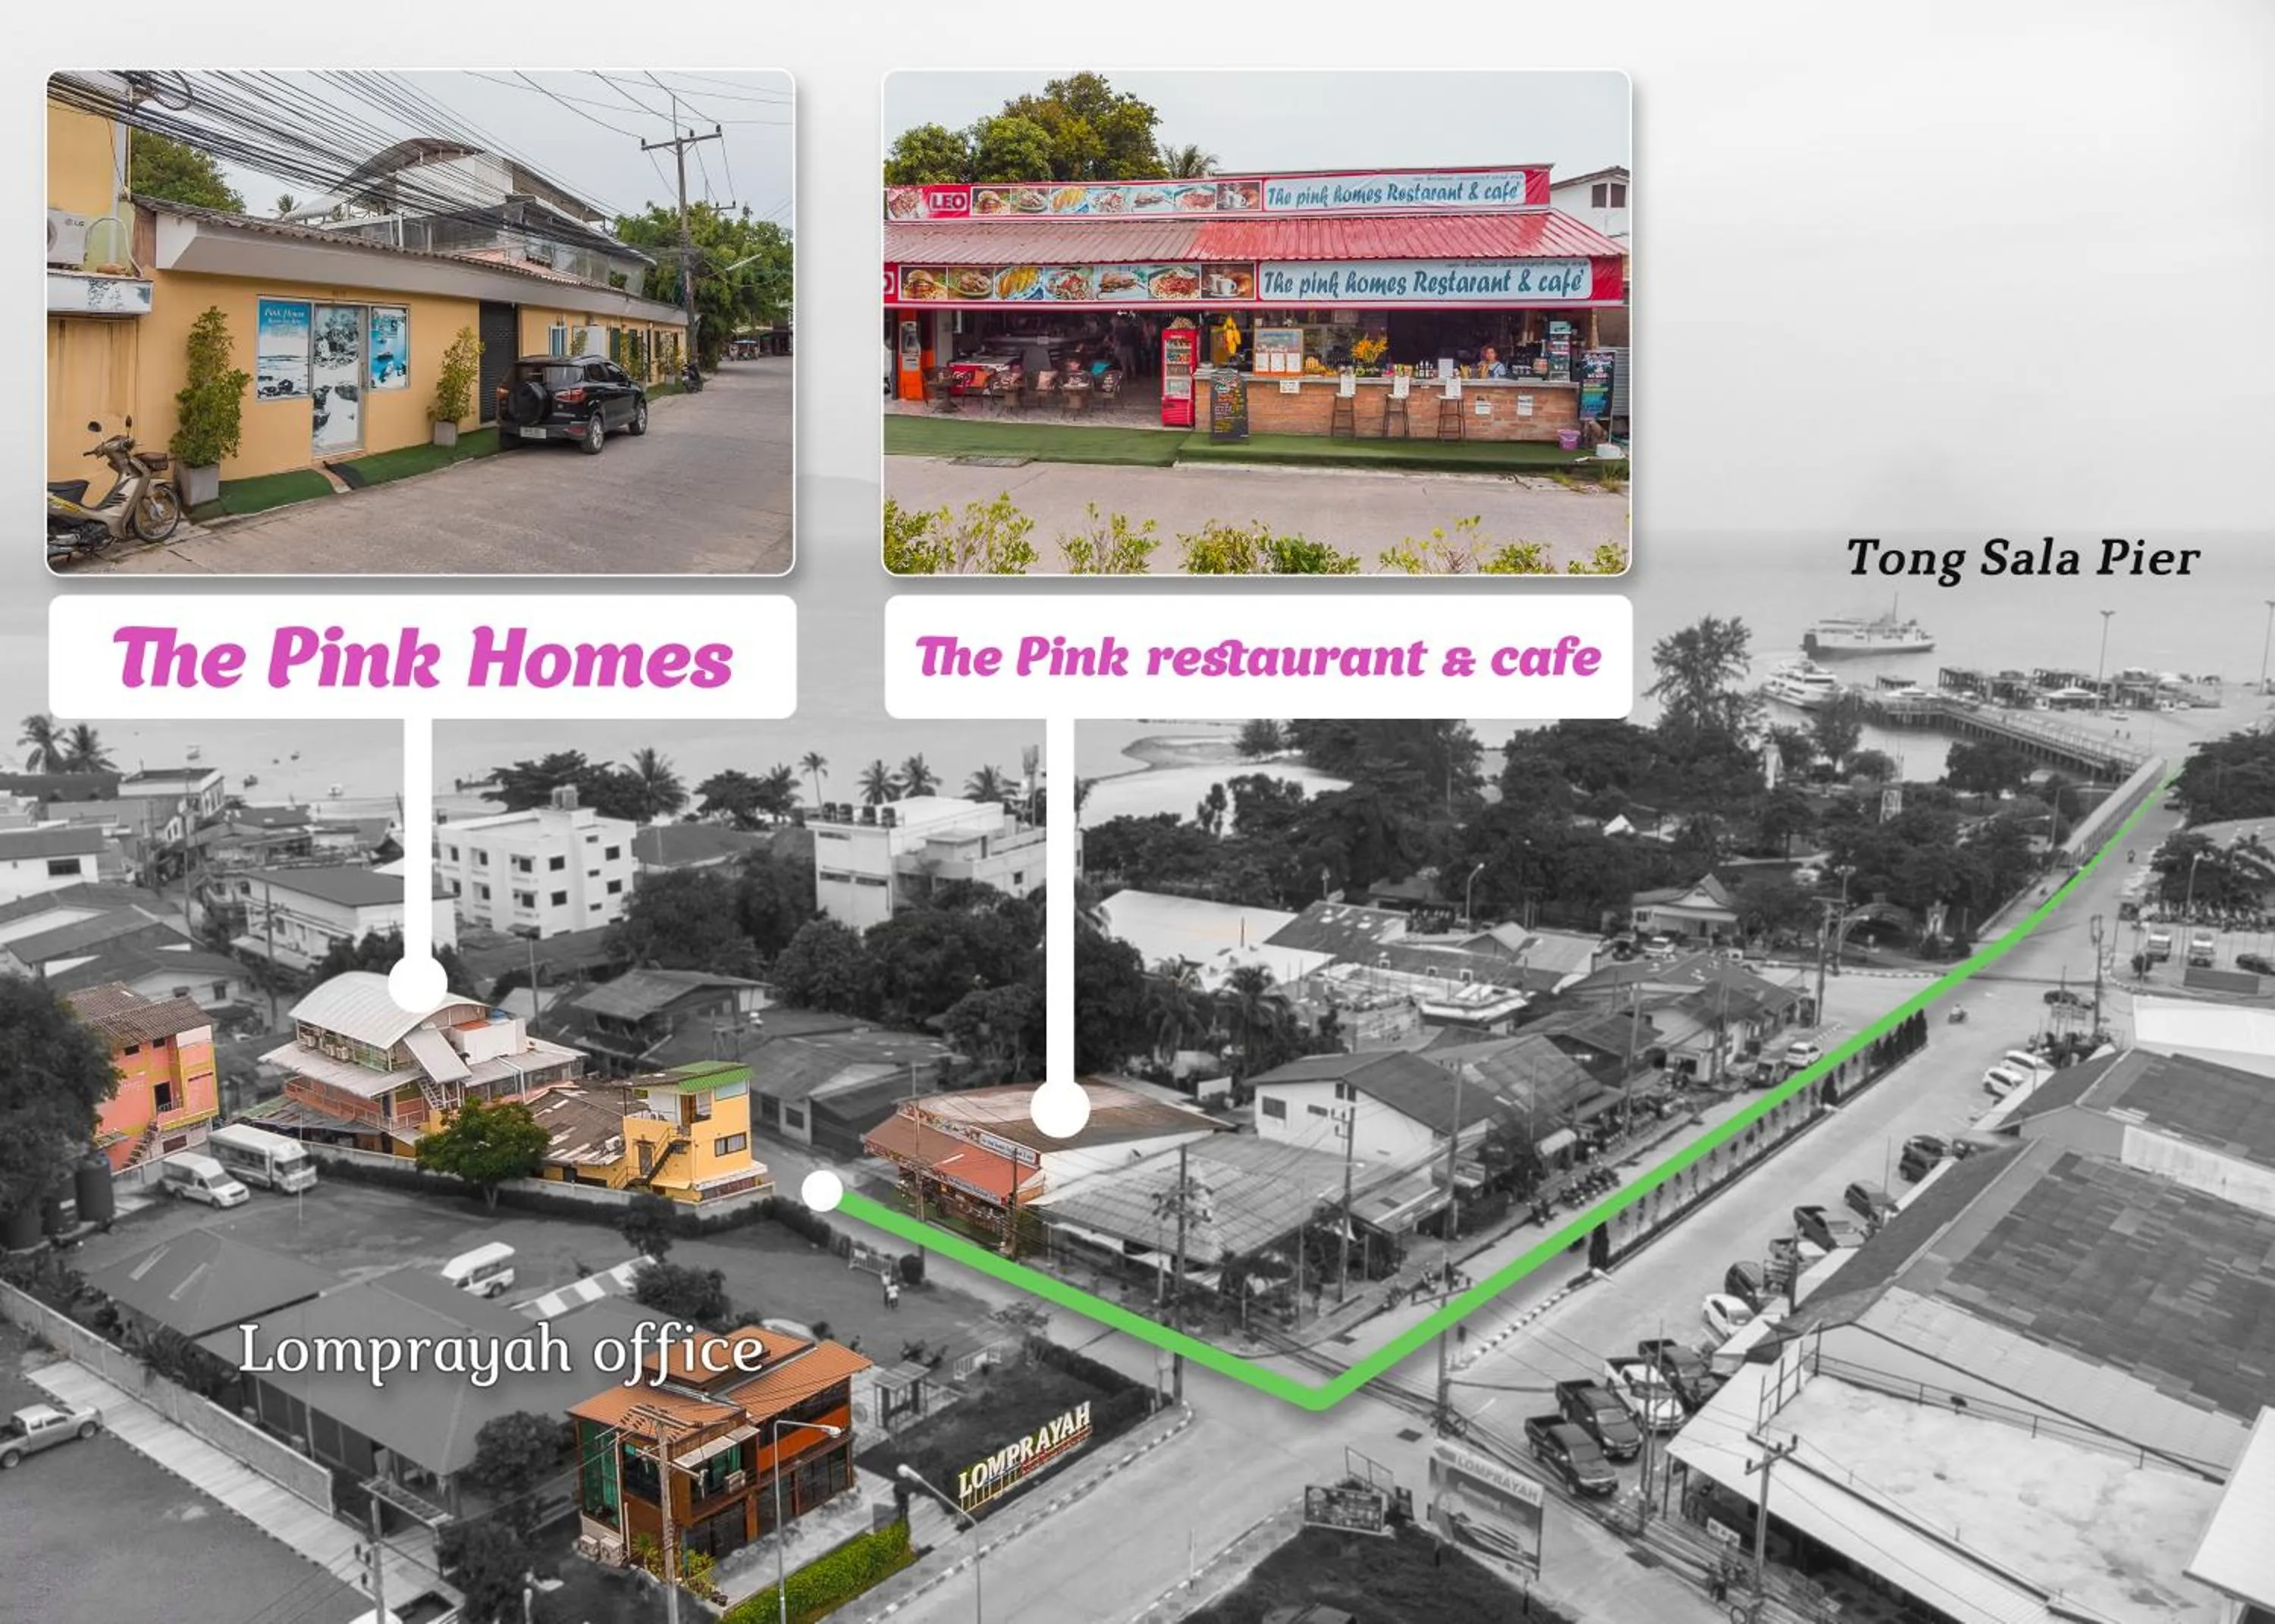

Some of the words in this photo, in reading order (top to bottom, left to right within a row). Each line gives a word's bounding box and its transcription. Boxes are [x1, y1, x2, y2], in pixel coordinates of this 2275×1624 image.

[931, 194, 966, 209] LEO
[1267, 187, 1291, 206] The
[1296, 185, 1329, 208] pink
[1333, 183, 1382, 204] homes
[1387, 181, 1463, 202] Restarant
[1468, 180, 1480, 201] &
[1264, 271, 1293, 293] The
[1299, 270, 1339, 299] pink
[1345, 270, 1407, 296] homes
[1413, 268, 1512, 296] Restarant
[1517, 268, 1532, 293] &
[958, 1400, 1091, 1499] LOMPRAYAH
[1457, 1448, 1539, 1503] LOMPRAYAH
